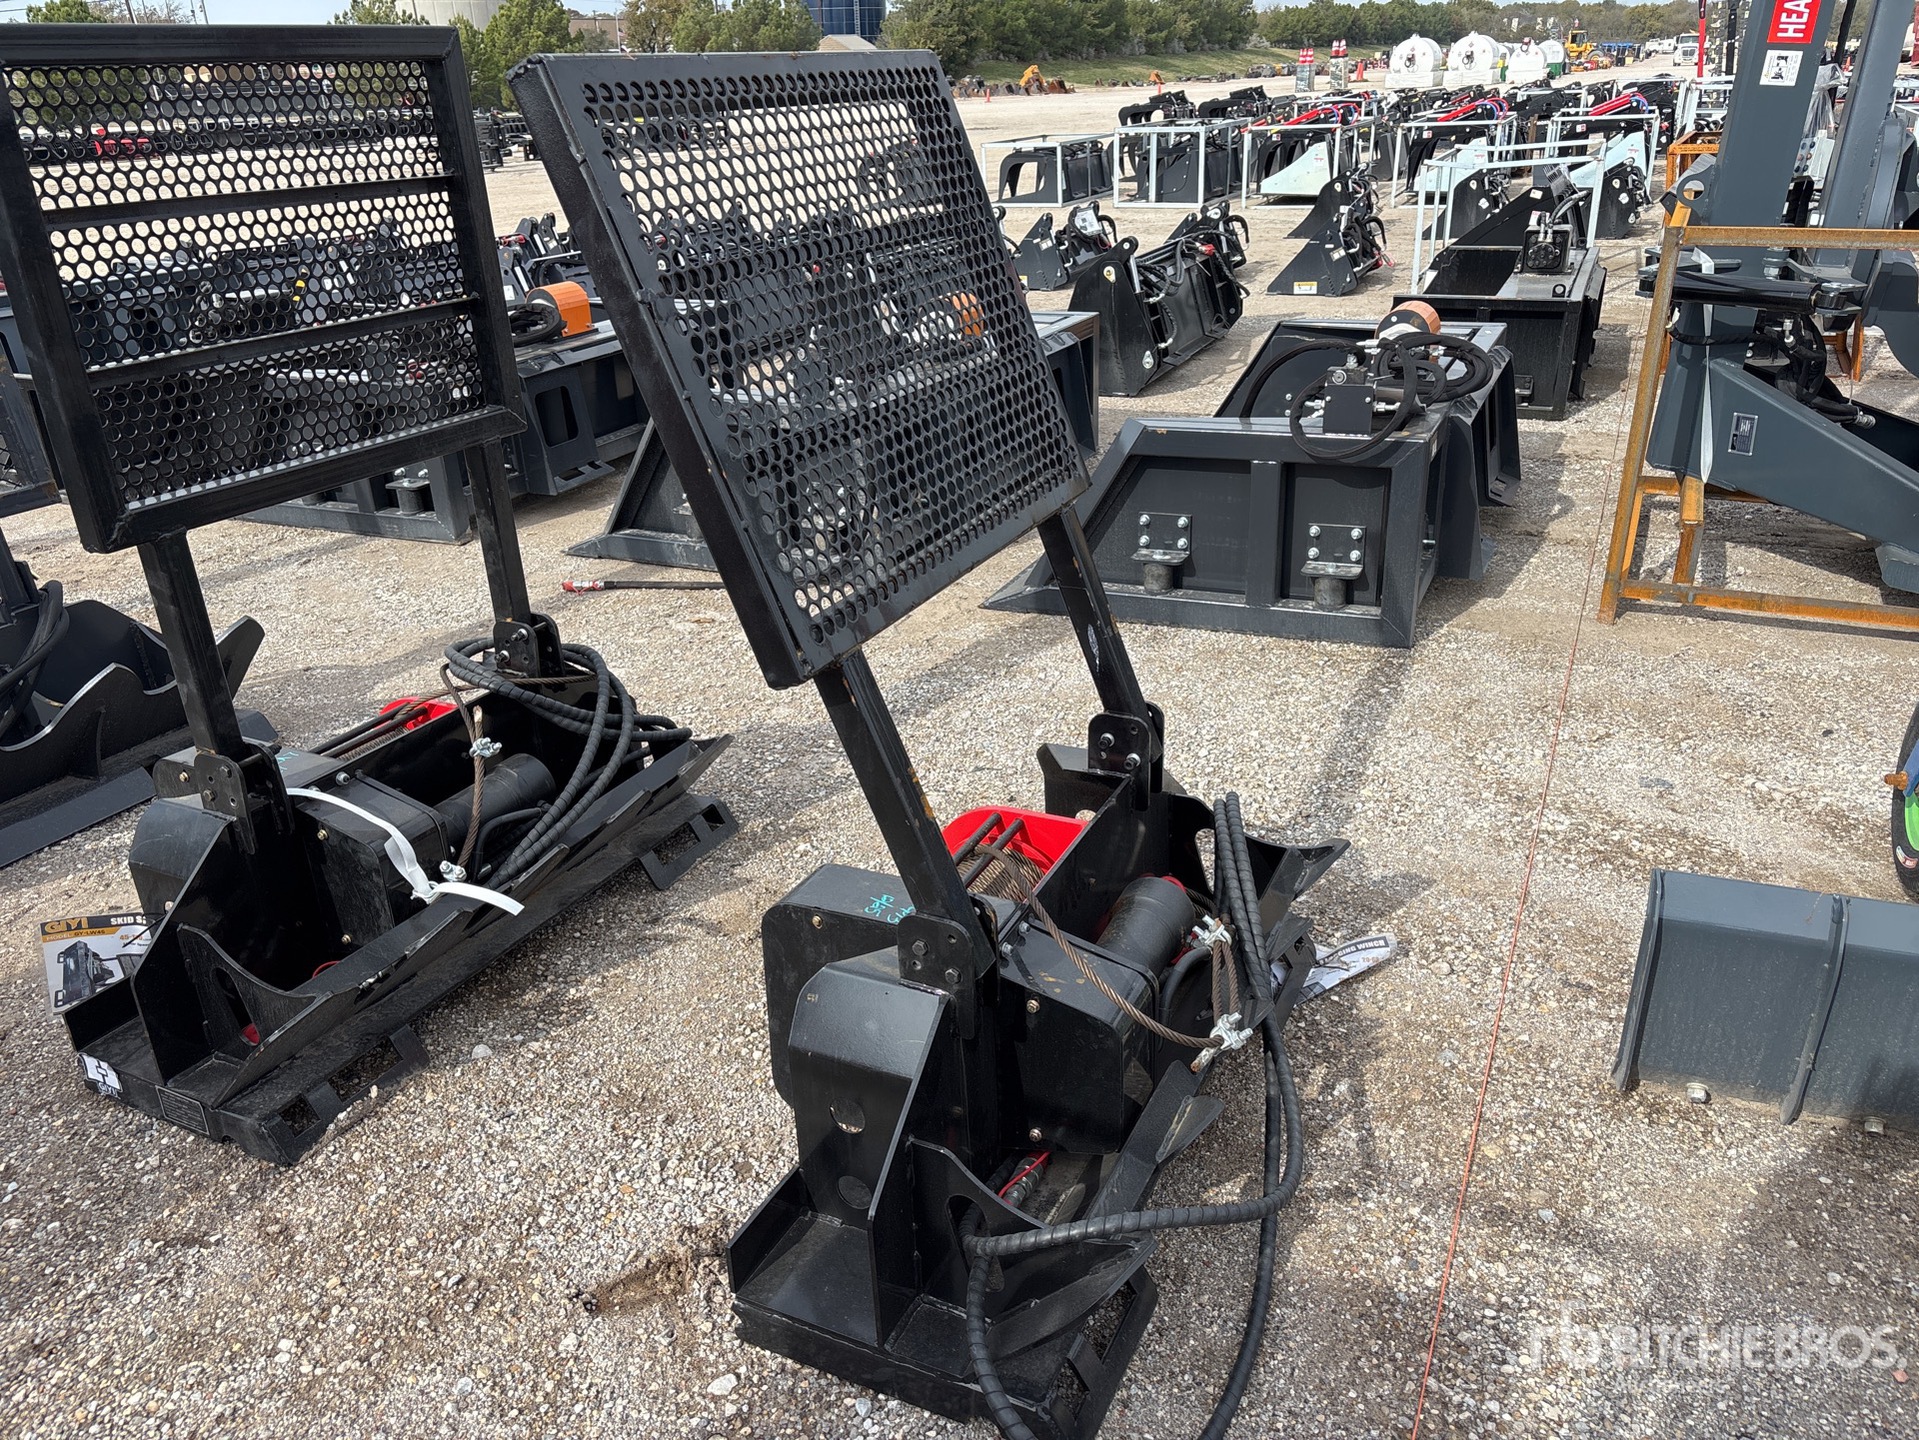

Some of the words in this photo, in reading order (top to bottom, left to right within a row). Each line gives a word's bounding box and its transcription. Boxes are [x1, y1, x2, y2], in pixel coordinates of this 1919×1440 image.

[44, 917, 89, 933] GIYI
[110, 916, 134, 925] SKID
[1356, 940, 1385, 949] WINCH
